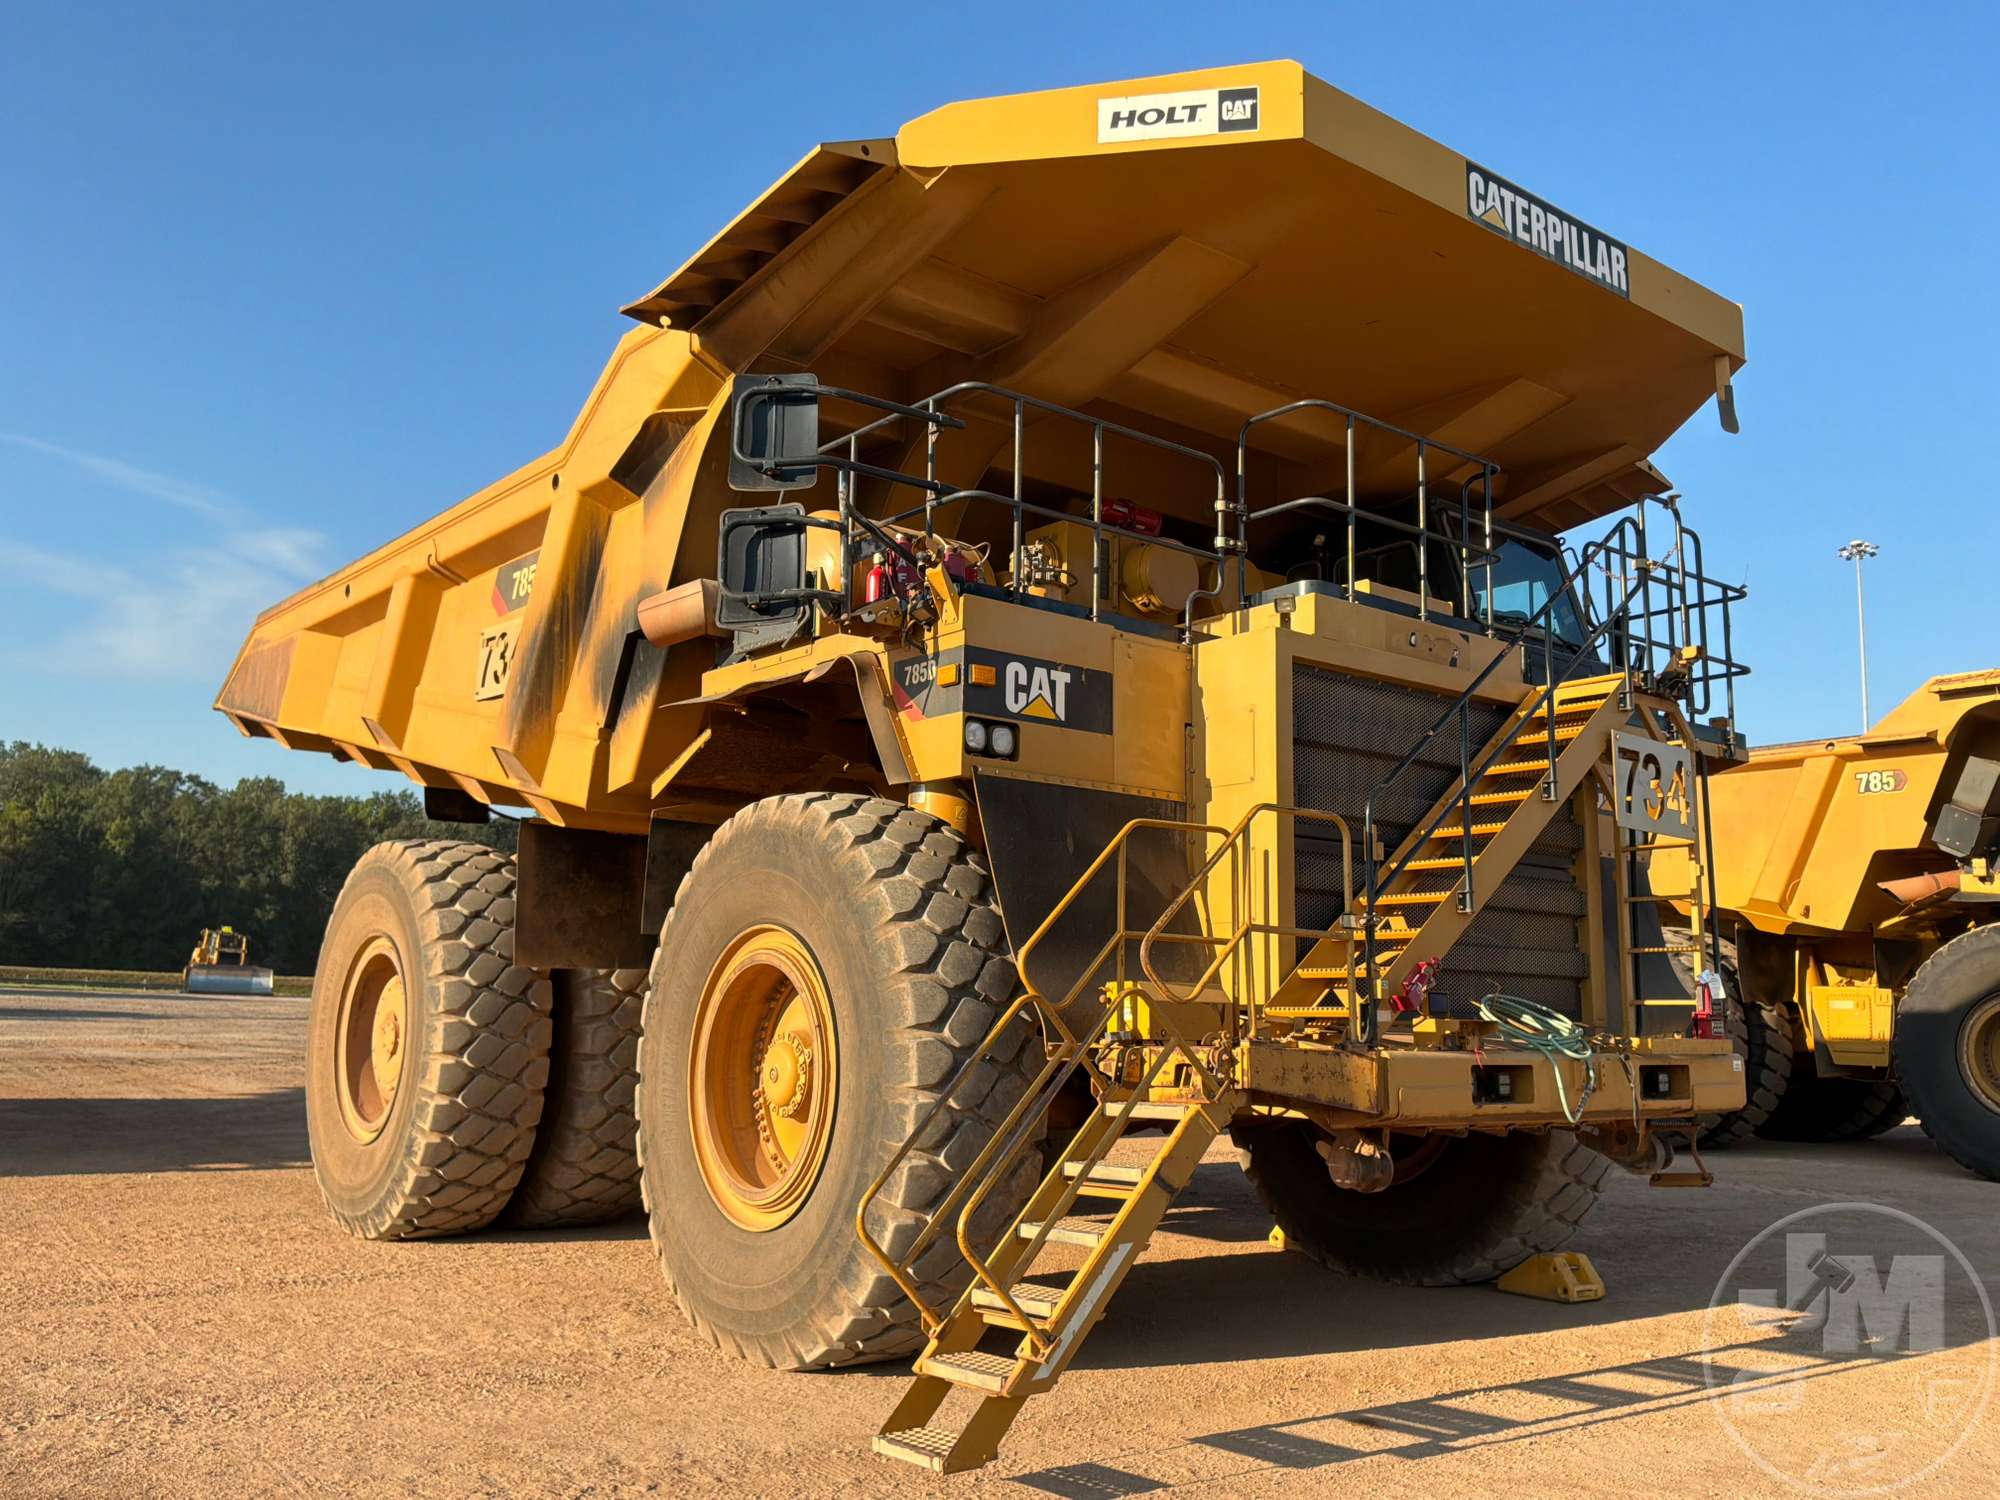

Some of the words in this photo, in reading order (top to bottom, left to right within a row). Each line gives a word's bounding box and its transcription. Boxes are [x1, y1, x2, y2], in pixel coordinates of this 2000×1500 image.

[1110, 104, 1206, 128] HOLT
[1222, 99, 1256, 121] CAT
[1469, 171, 1627, 291] CATERPILLAR
[482, 632, 518, 688] 73
[904, 660, 936, 686] 785D
[1005, 661, 1070, 721] CAT
[1618, 747, 1689, 825] 734
[1855, 771, 1895, 793] 785
